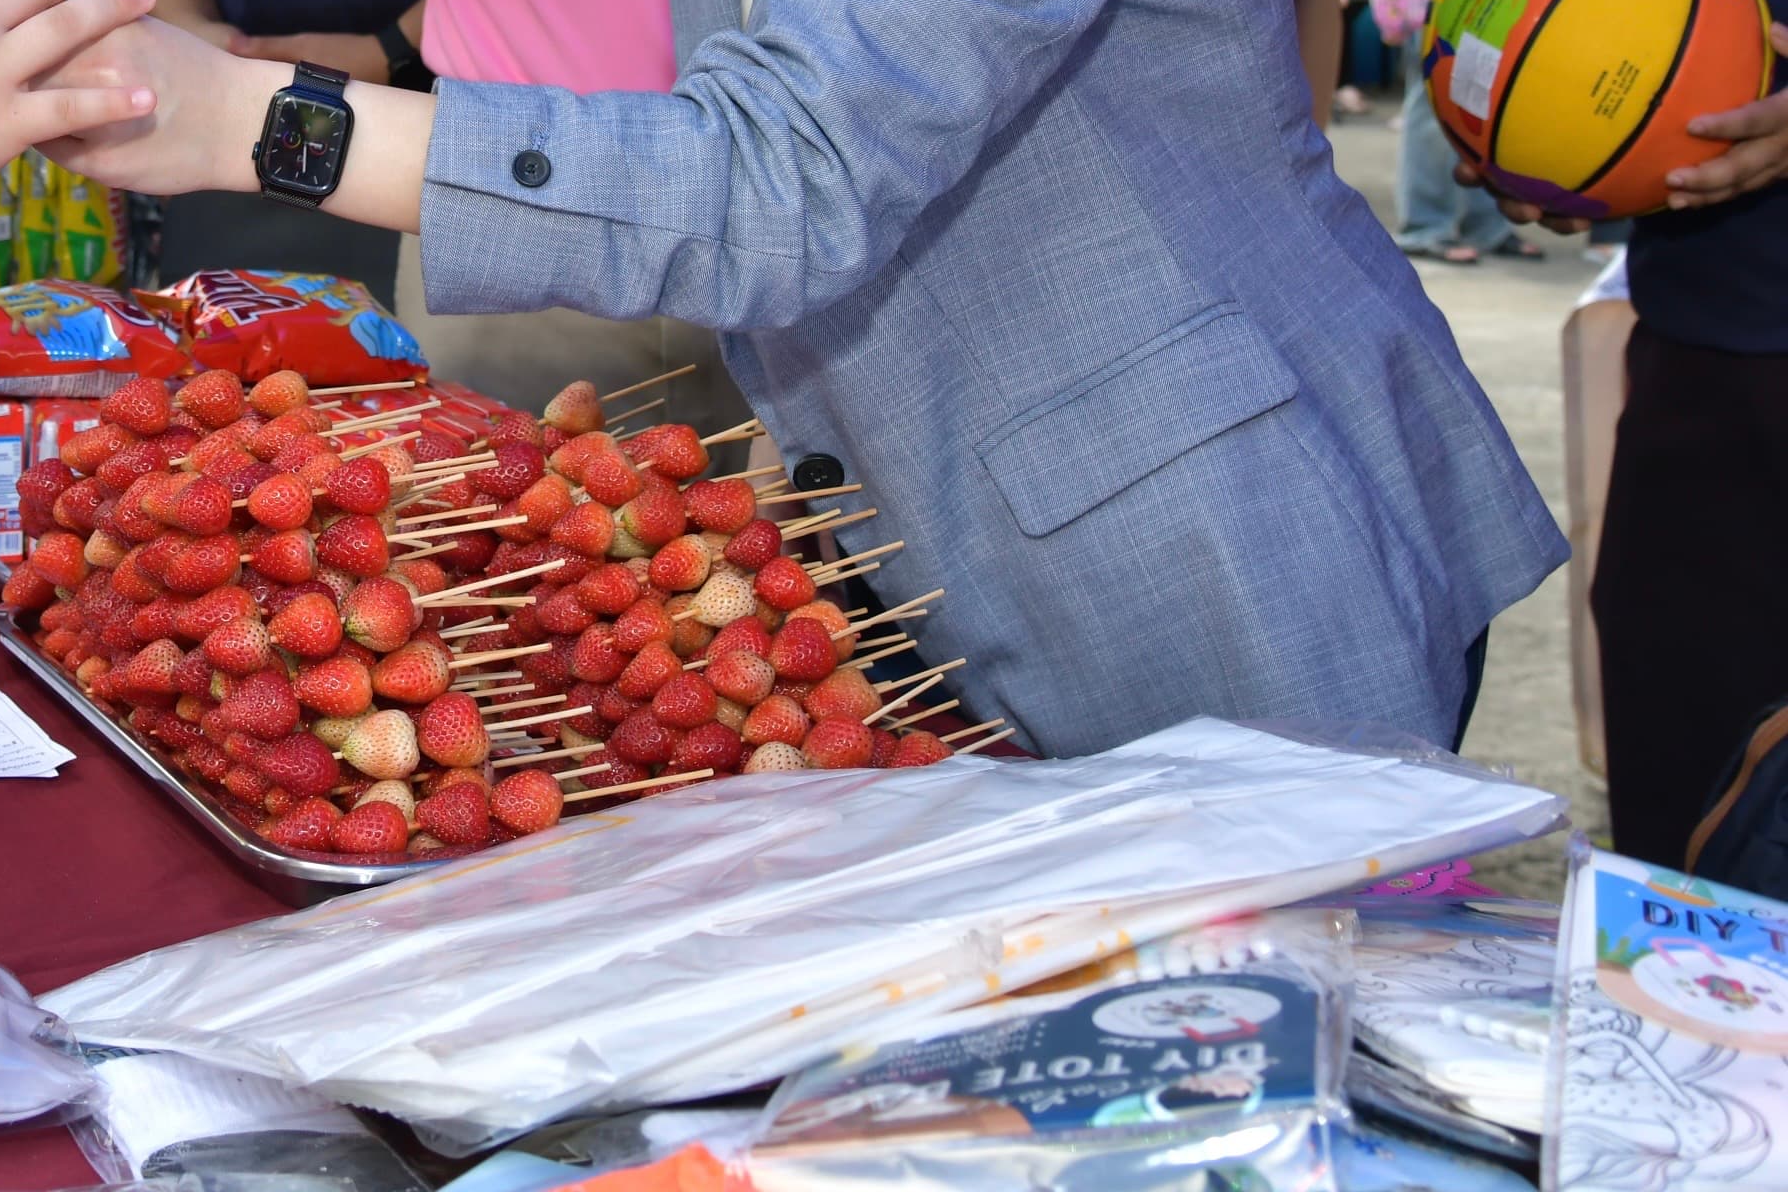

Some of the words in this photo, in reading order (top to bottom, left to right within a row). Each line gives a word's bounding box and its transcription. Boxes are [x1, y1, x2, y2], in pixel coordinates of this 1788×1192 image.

[1642, 899, 1741, 942] DIY
[972, 1053, 1132, 1093] TOTE
[1150, 1042, 1267, 1076] DIY
